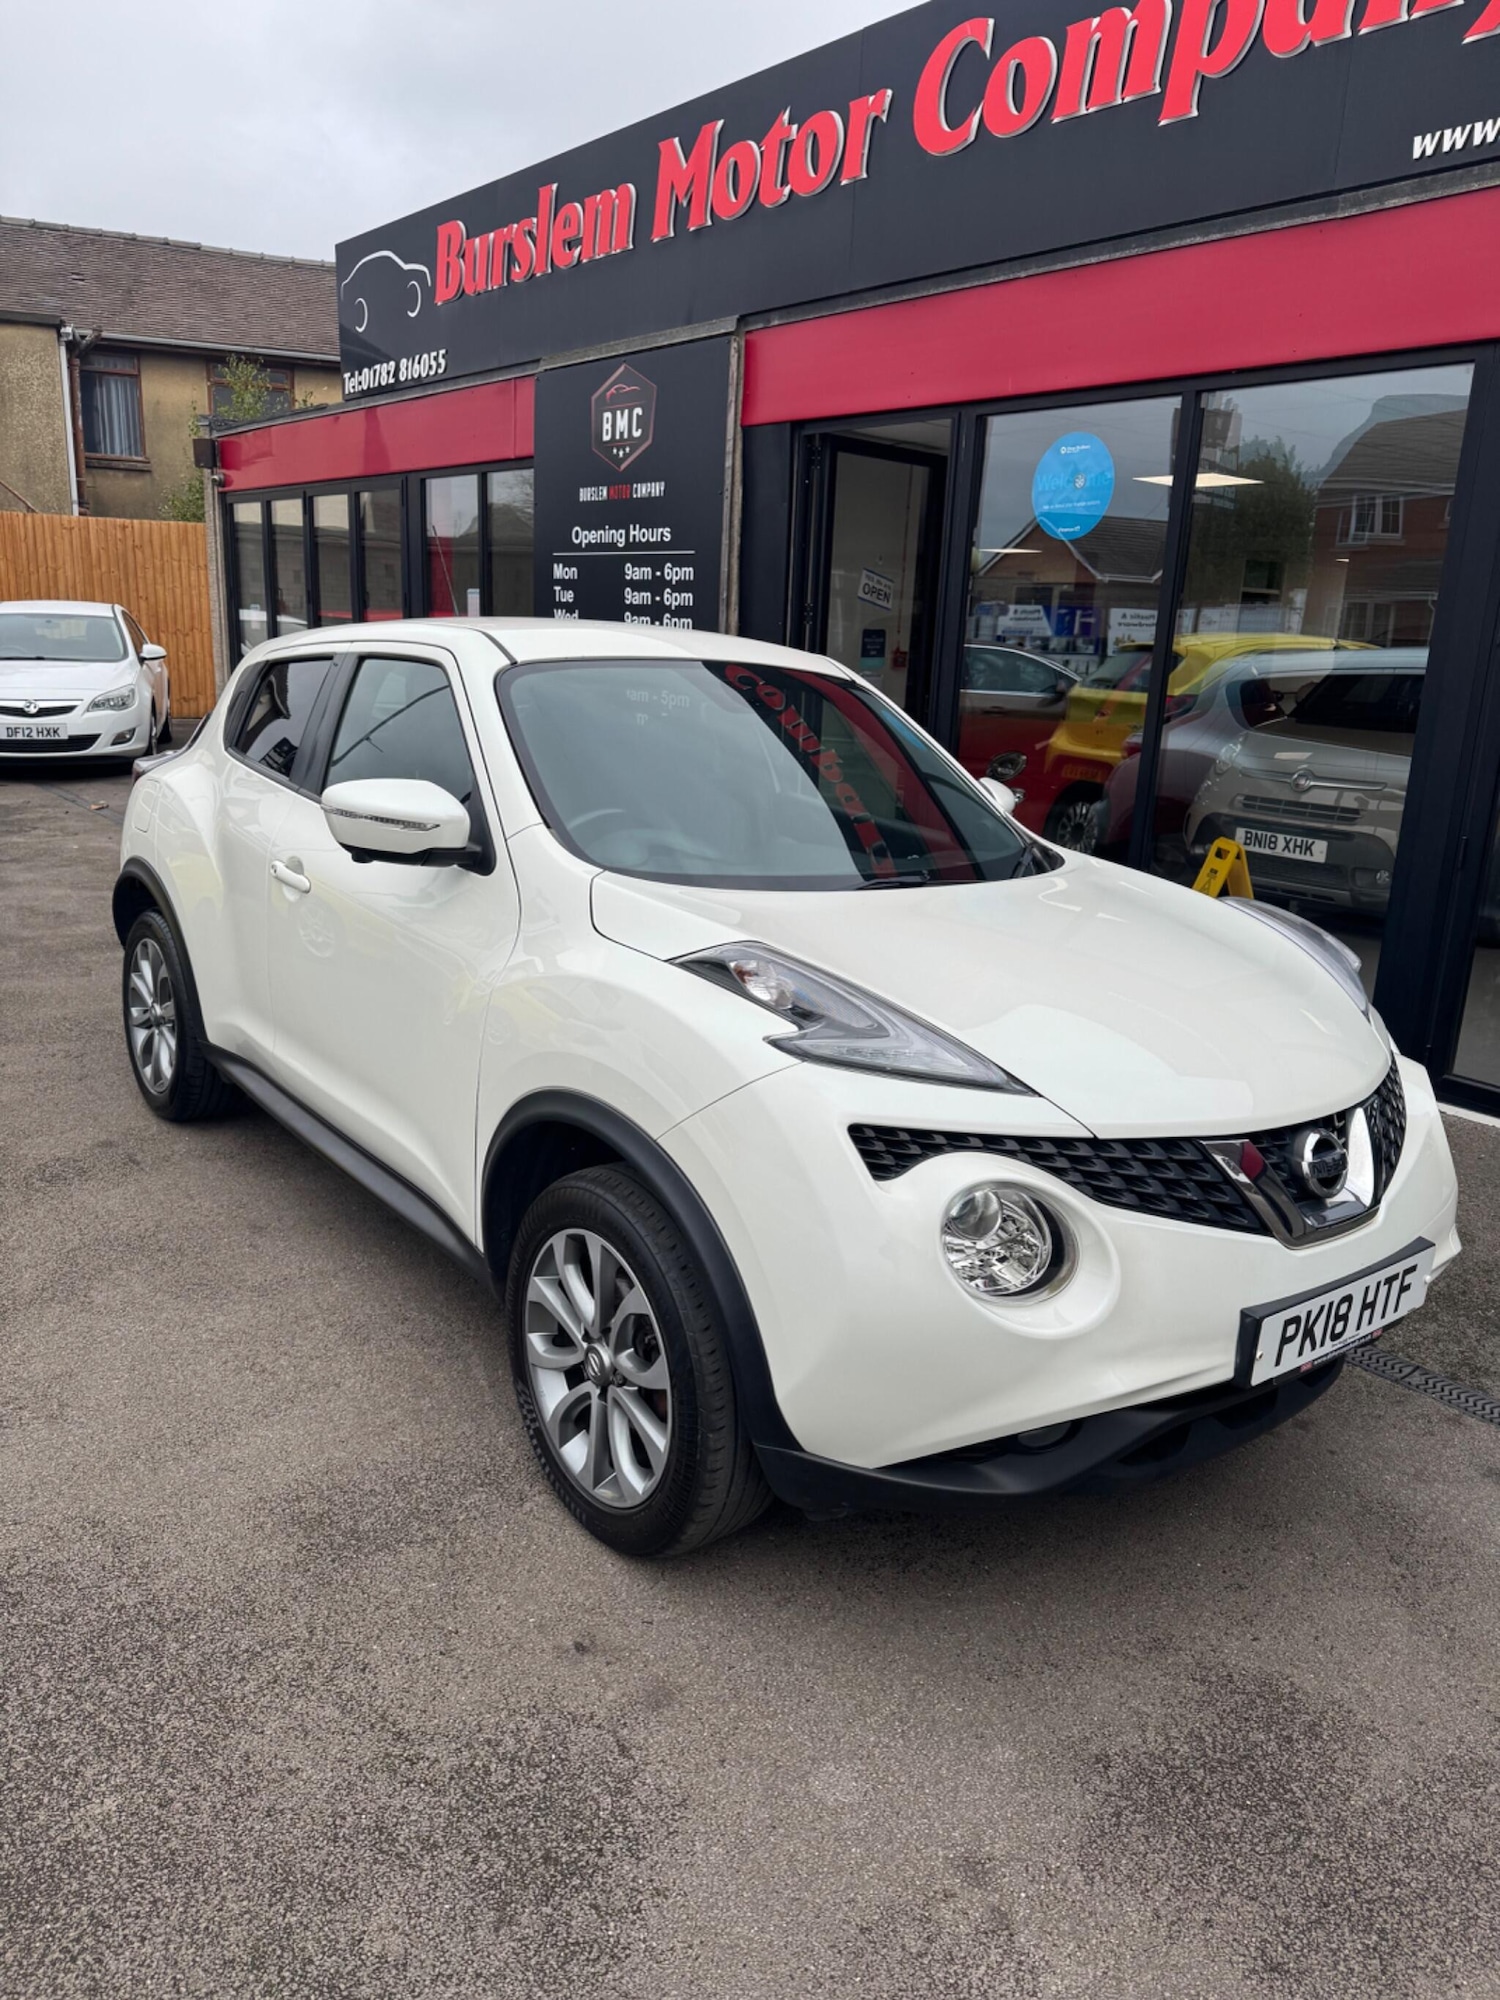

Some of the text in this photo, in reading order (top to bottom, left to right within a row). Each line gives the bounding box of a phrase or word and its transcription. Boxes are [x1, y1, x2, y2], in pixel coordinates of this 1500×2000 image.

[434, 0, 1500, 306] Burslem Motor Comp
[343, 349, 447, 395] Tel:01782 816055
[602, 407, 644, 442] BMC
[579, 481, 666, 502] BURSLEM MOTOR COMPANY
[571, 524, 672, 548] Opening Hours
[553, 562, 578, 580] Mon
[624, 563, 652, 581] 9am
[664, 562, 694, 585] 6pm
[554, 586, 574, 603] Tue
[624, 587, 651, 605] 9am
[663, 587, 693, 610] 6pm
[862, 583, 891, 603] OPEN
[660, 690, 690, 710] 5pm
[6, 727, 61, 738] DF12 HXK
[1243, 830, 1316, 857] BN18 XHK
[1274, 1293, 1354, 1367] PK18
[1356, 1264, 1418, 1331] HTF
